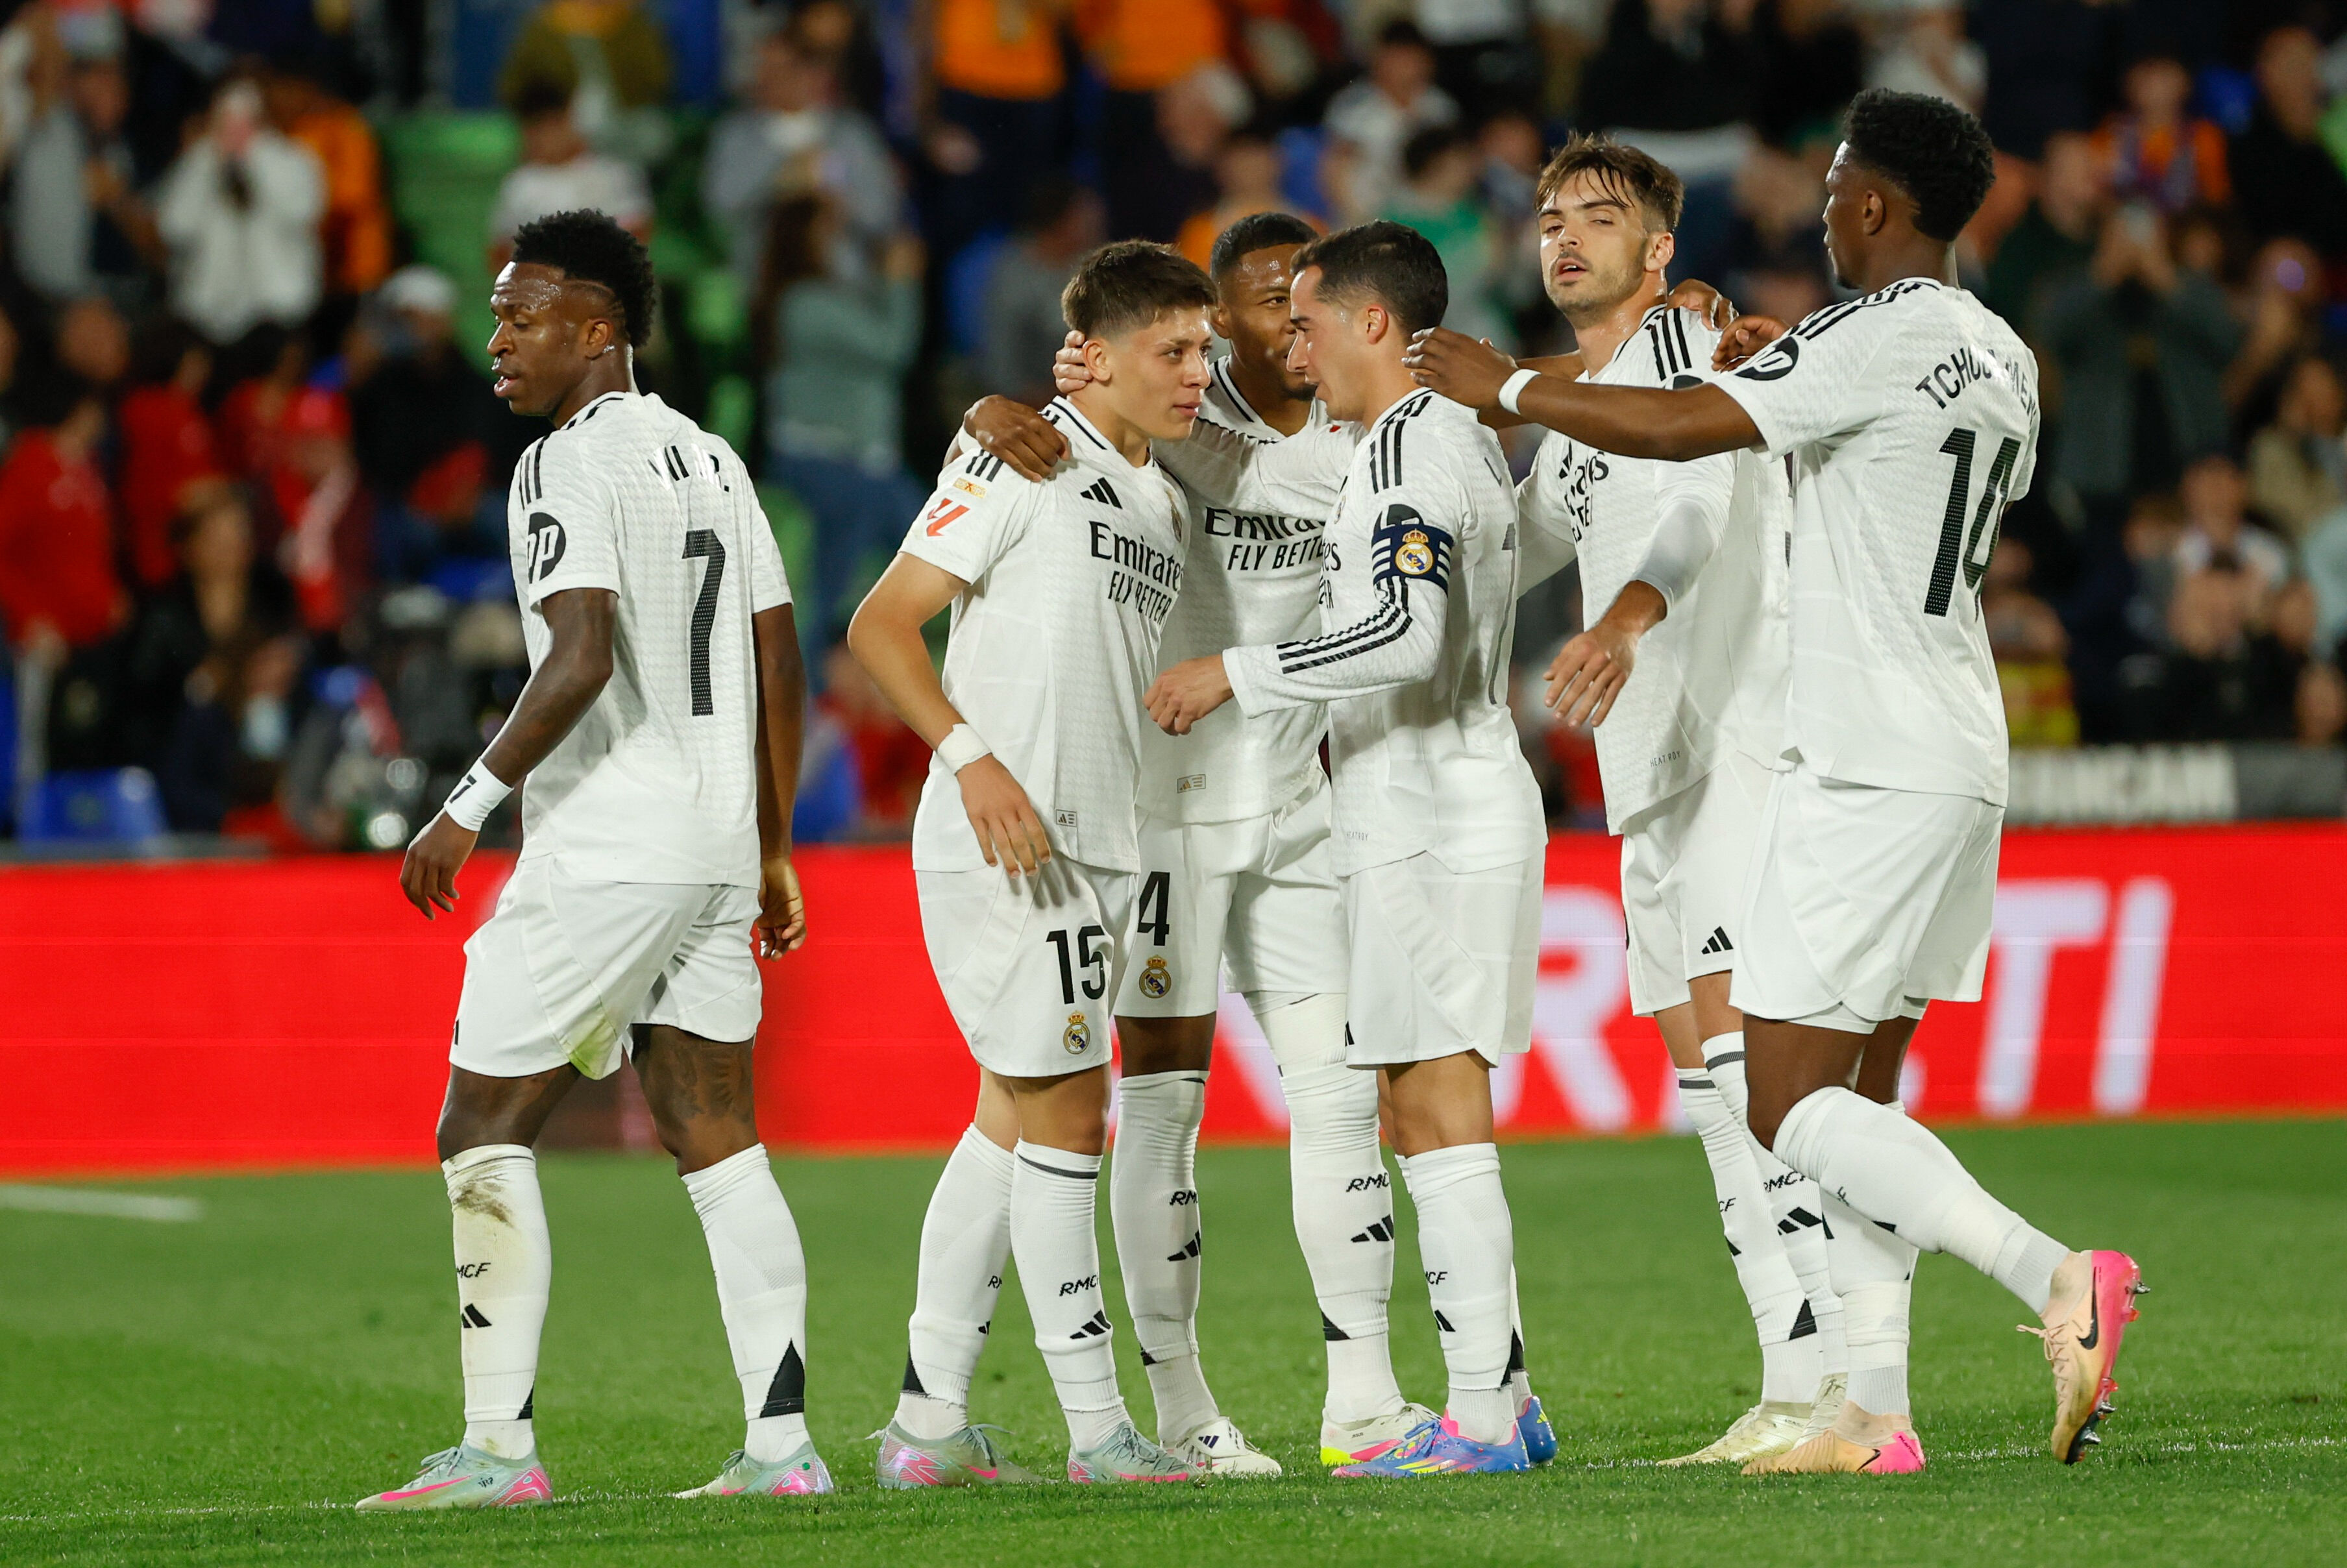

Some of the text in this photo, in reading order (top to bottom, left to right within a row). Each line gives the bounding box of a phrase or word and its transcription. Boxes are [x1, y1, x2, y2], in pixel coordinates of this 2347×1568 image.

[1088, 521, 1184, 591] Emirate
[1227, 545, 1268, 570] FLY
[1923, 427, 2022, 622] 14
[1108, 570, 1134, 604] FLY
[682, 529, 726, 717] 7
[449, 774, 477, 803] 7
[1137, 872, 1170, 946] 4
[1046, 925, 1106, 1005] 15
[1059, 1274, 1099, 1297] RMC
